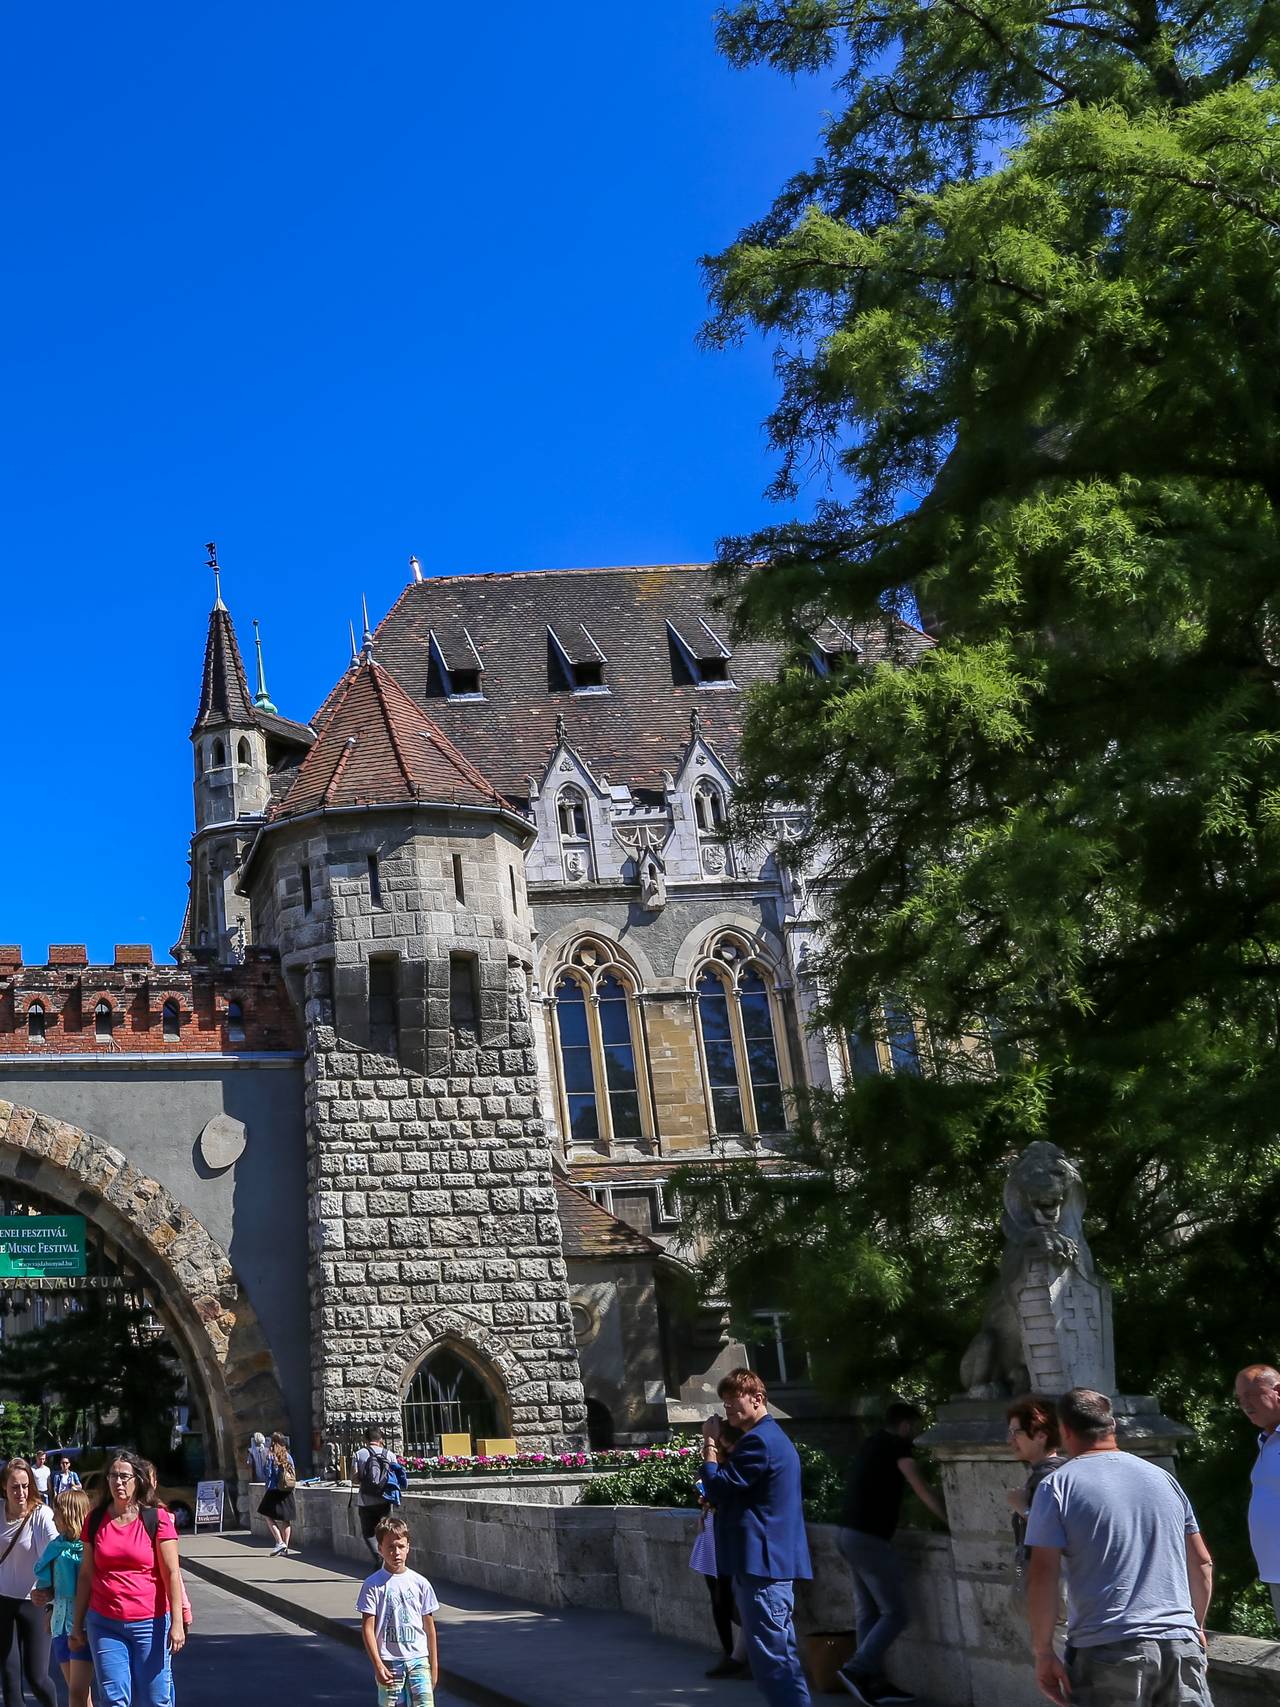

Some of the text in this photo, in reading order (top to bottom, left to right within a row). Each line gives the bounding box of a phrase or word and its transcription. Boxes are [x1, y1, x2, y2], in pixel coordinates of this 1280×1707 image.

[21, 1225, 68, 1238] FESZTIVÁL
[8, 1243, 36, 1253] MUSIC
[38, 1242, 79, 1253] FESTIVAL
